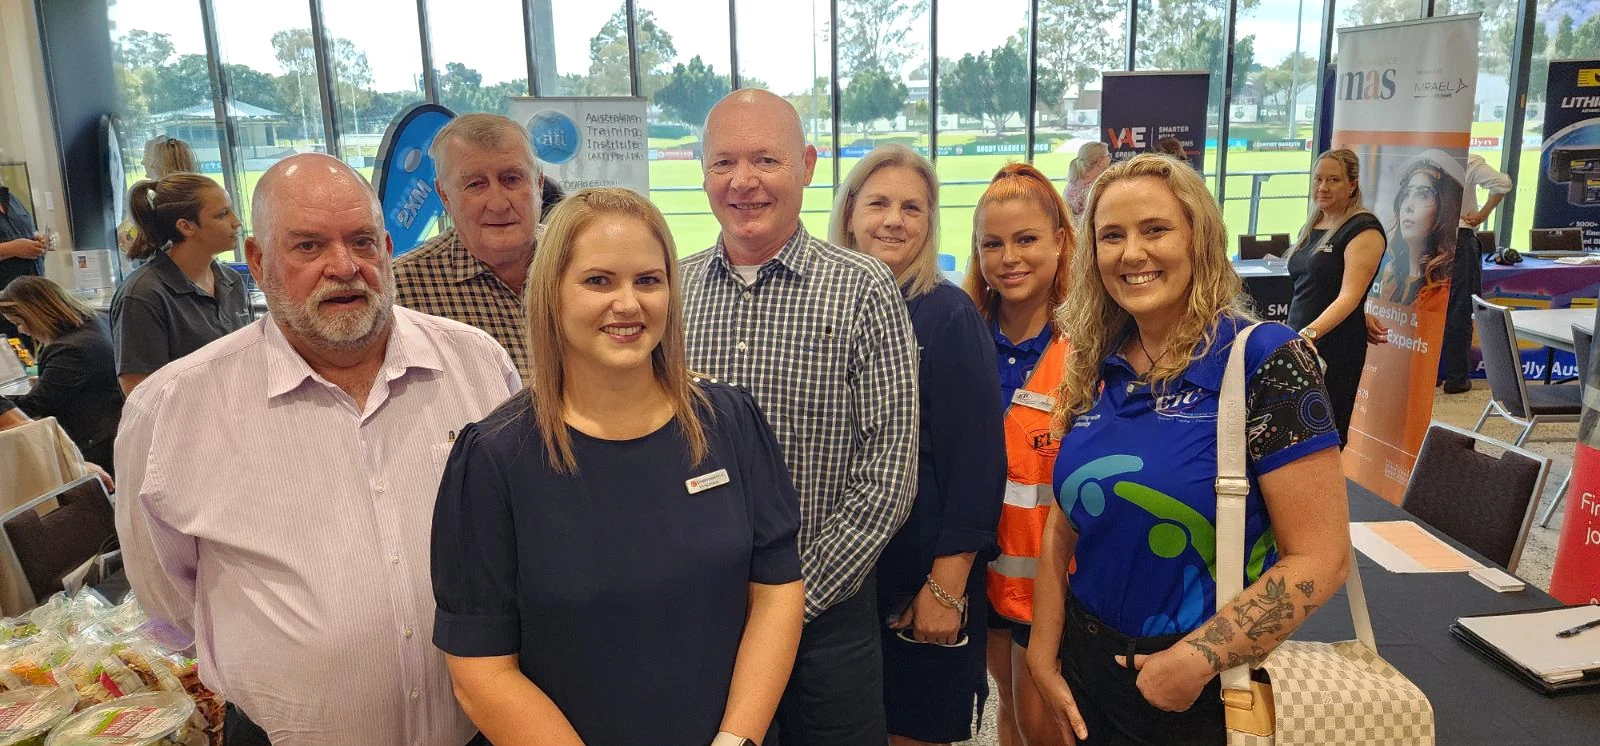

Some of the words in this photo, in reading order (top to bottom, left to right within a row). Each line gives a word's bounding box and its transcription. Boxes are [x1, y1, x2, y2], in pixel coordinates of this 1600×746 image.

[1106, 126, 1146, 149] VAE
[397, 179, 432, 229] 2XM
[1387, 329, 1428, 354] Experts
